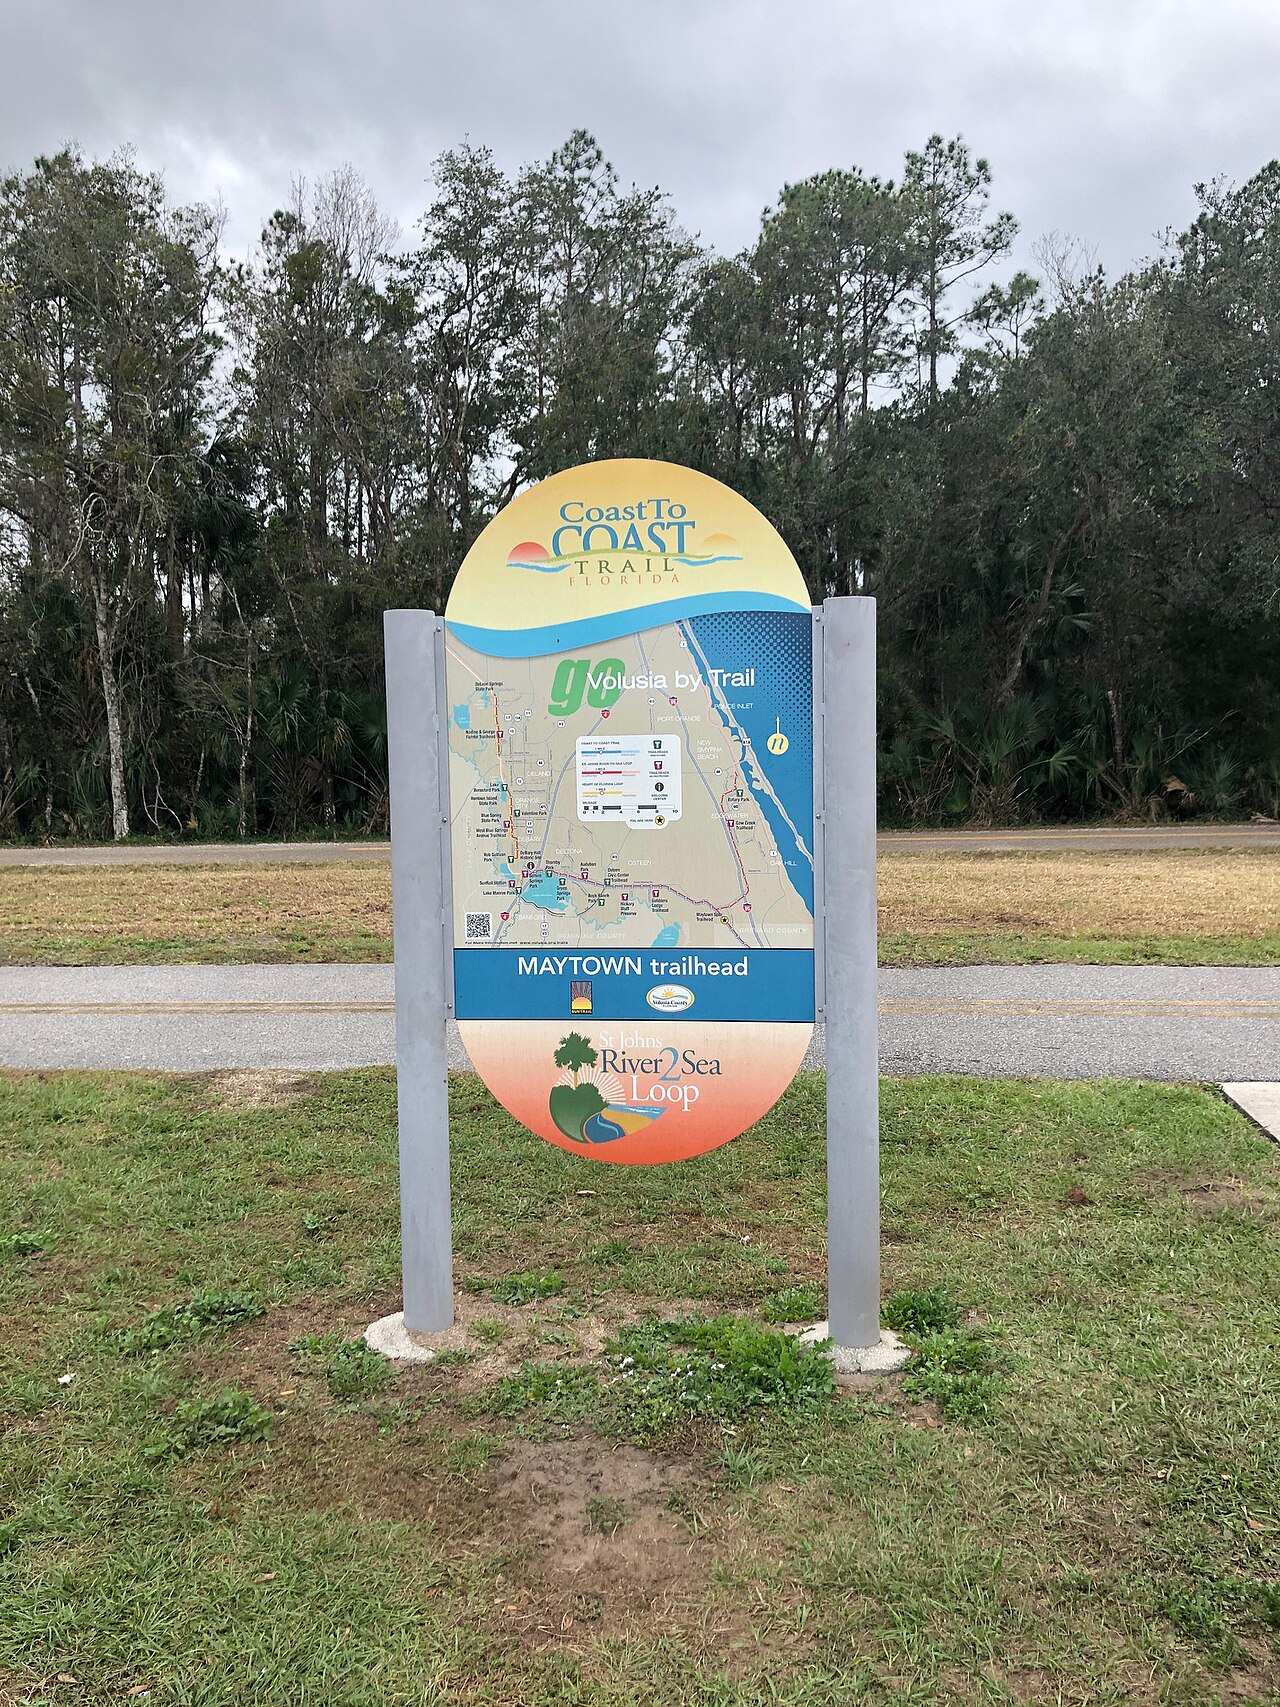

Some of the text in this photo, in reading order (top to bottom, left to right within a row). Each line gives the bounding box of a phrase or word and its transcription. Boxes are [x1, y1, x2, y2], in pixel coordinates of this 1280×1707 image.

[559, 498, 687, 523] Coast To
[552, 521, 696, 557] COAST
[574, 558, 675, 574] TRAIL
[569, 574, 680, 586] FLORIDA
[546, 657, 626, 717] go
[586, 668, 755, 692] Volusia by Trail
[518, 955, 748, 976] MAYTOWN trailhead
[599, 1030, 663, 1051] St Johns
[629, 1074, 700, 1112] Loop
